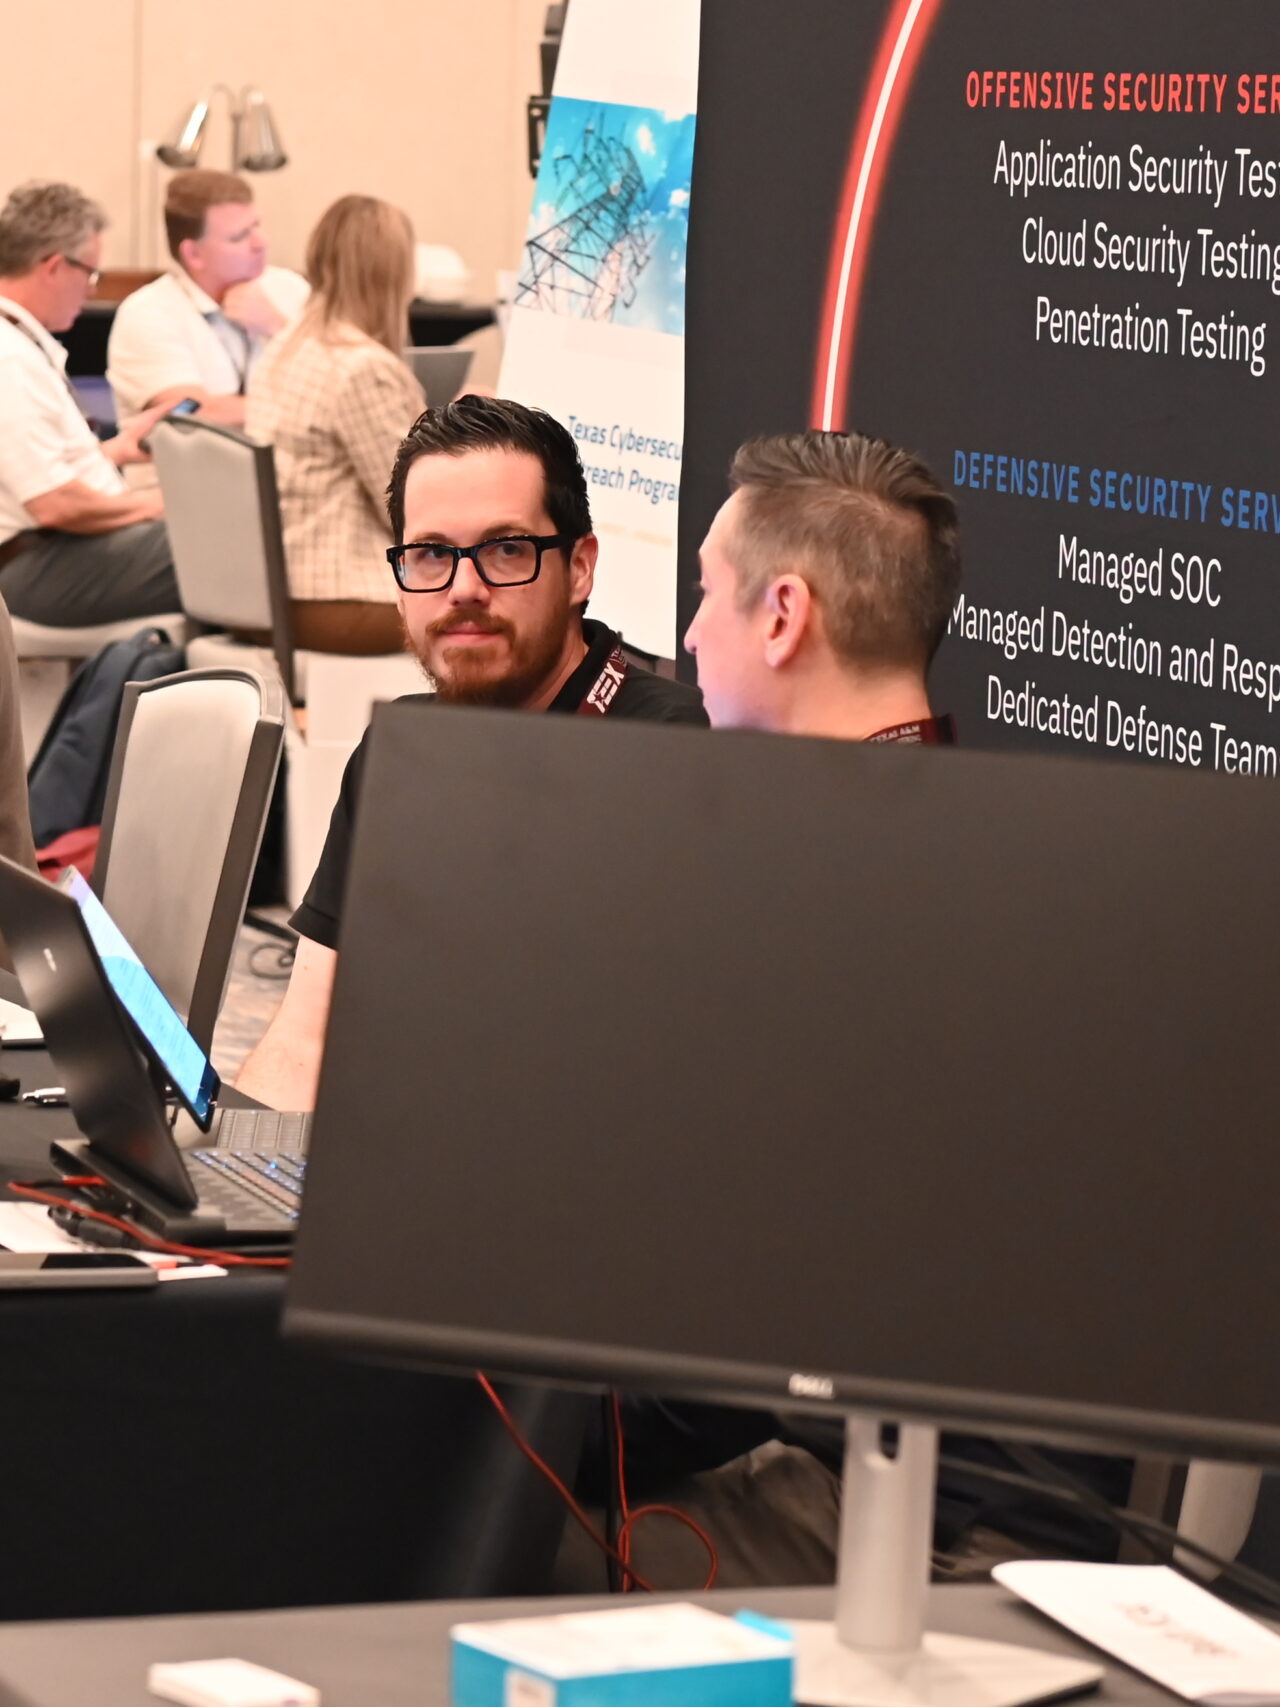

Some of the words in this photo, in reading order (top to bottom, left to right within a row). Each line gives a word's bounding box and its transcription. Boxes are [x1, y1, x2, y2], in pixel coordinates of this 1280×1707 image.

[966, 71, 1094, 110] OFFENSIVE
[1103, 72, 1227, 113] SECURITY
[993, 139, 1121, 198] Application
[1128, 143, 1228, 208] Security
[1234, 148, 1280, 198] Tes
[1022, 216, 1087, 267] Cloud
[1093, 221, 1190, 287] Security
[1197, 228, 1280, 295] Testing
[1036, 296, 1168, 354] Penetration
[1176, 302, 1267, 377] Testing
[568, 415, 607, 445] Texas
[628, 469, 679, 505] Progra
[953, 450, 1080, 503] DEFENSIVE
[1089, 468, 1212, 522] SECURITY
[1058, 534, 1163, 604] Managed
[1170, 552, 1222, 607] SOC
[947, 593, 1044, 660] Managed
[1051, 611, 1162, 677] Detection
[1169, 638, 1215, 688] and
[586, 661, 625, 714] TEEX
[987, 674, 1098, 743] Dedicated
[1105, 700, 1203, 766] Defense
[1210, 722, 1280, 779] Team
